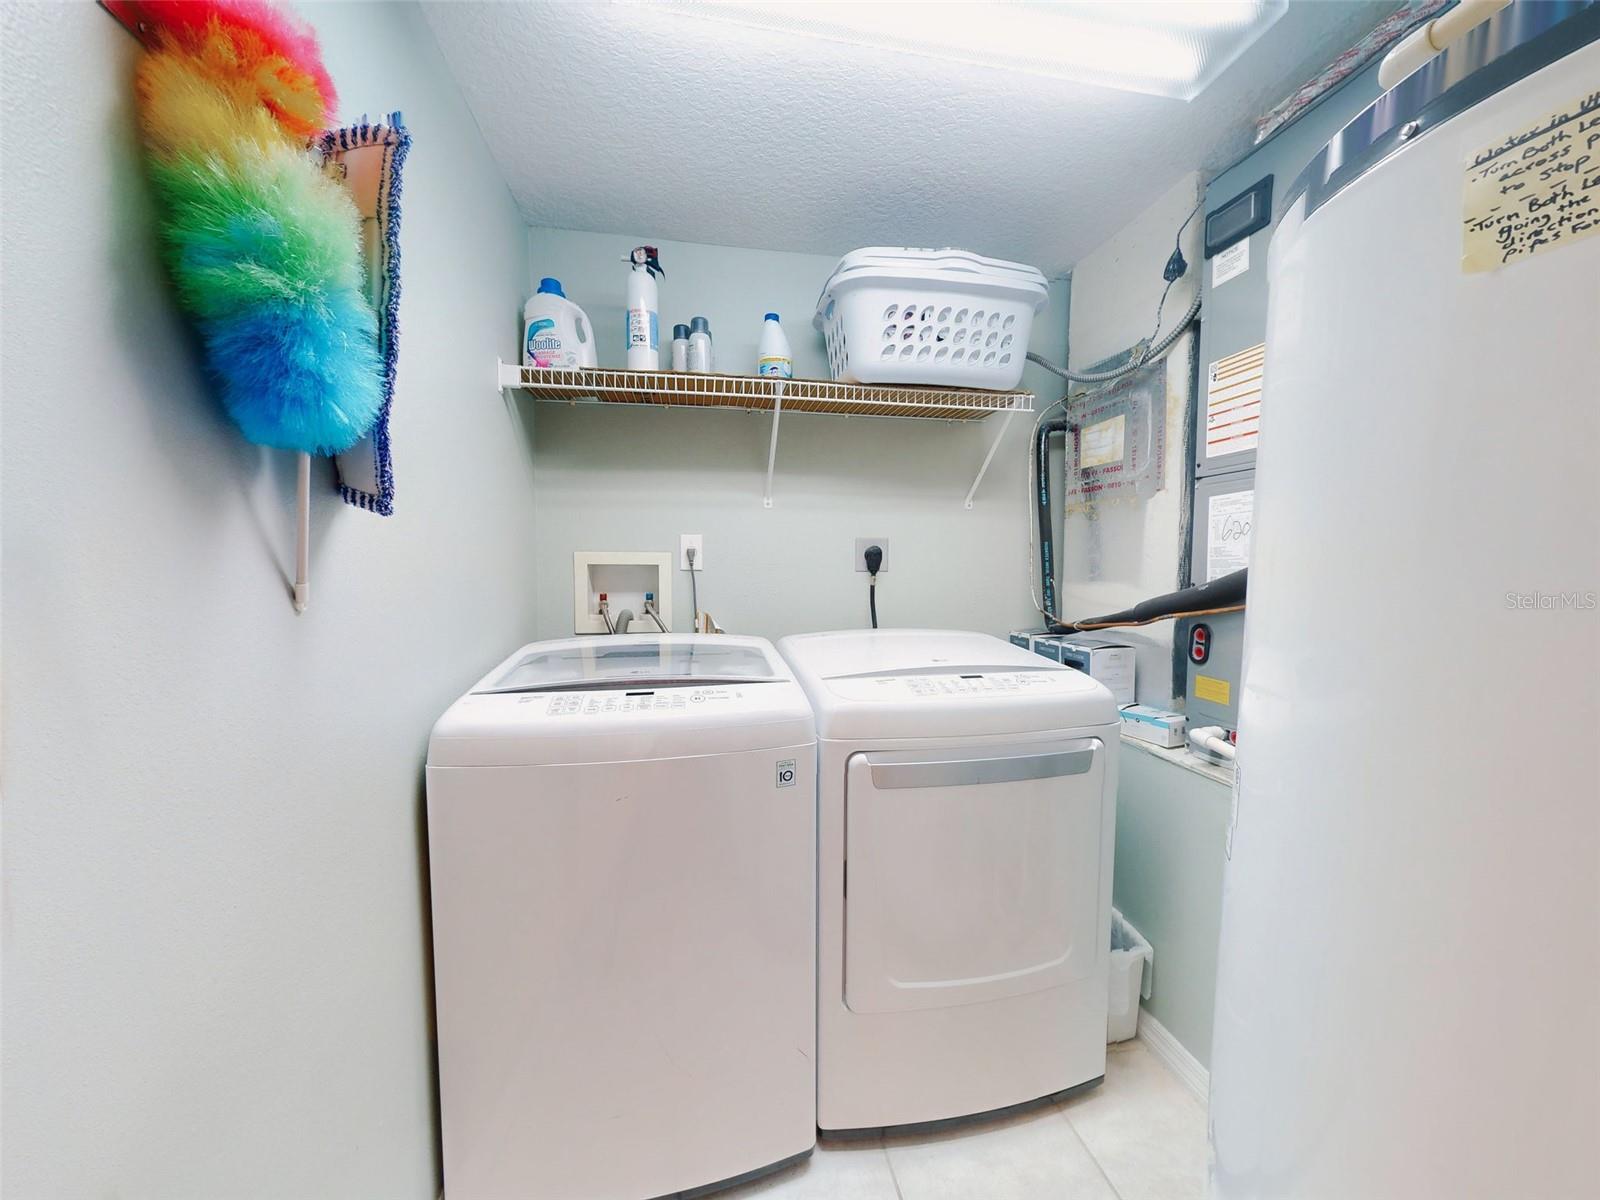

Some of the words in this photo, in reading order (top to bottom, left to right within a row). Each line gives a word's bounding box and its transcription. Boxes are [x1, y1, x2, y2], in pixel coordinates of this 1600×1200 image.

[1522, 131, 1572, 160] Both
[1498, 145, 1572, 182] across
[1500, 182, 1525, 195] to
[1528, 185, 1574, 213] Both
[1496, 214, 1551, 244] going
[1557, 195, 1591, 212] the
[1502, 208, 1599, 250] direction
